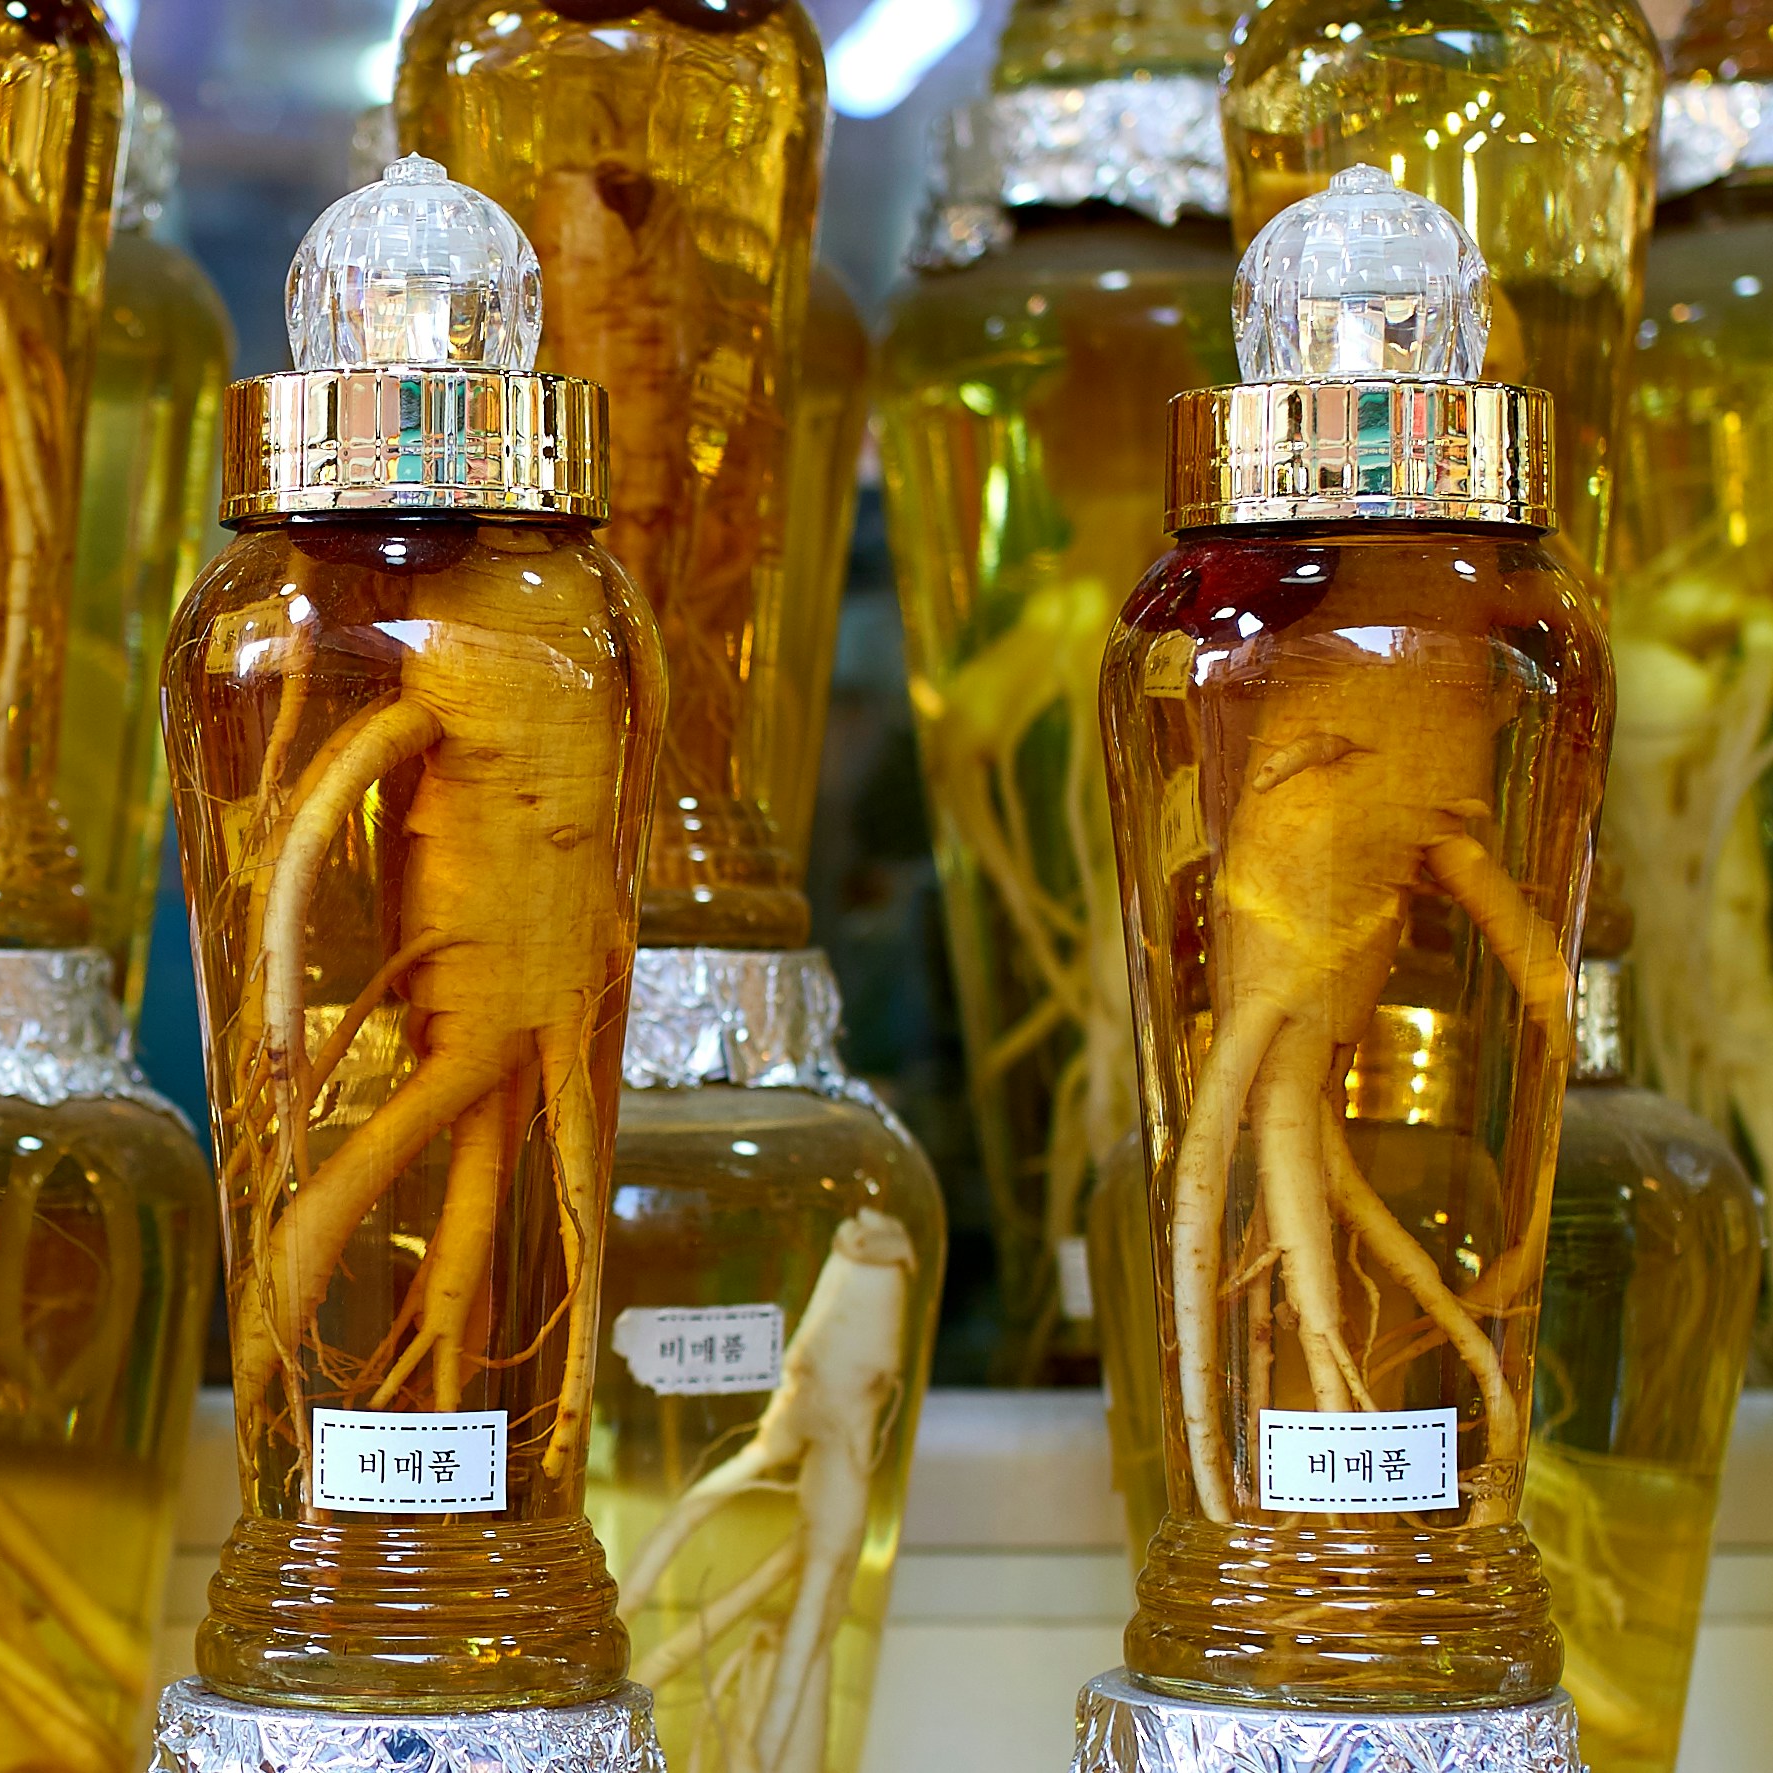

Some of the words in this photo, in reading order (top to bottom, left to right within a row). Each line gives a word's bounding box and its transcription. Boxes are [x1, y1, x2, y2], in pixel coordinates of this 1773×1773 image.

[659, 1333, 746, 1365] 비매품
[358, 1449, 461, 1485] 비매품
[1308, 1448, 1412, 1484] 비매품
